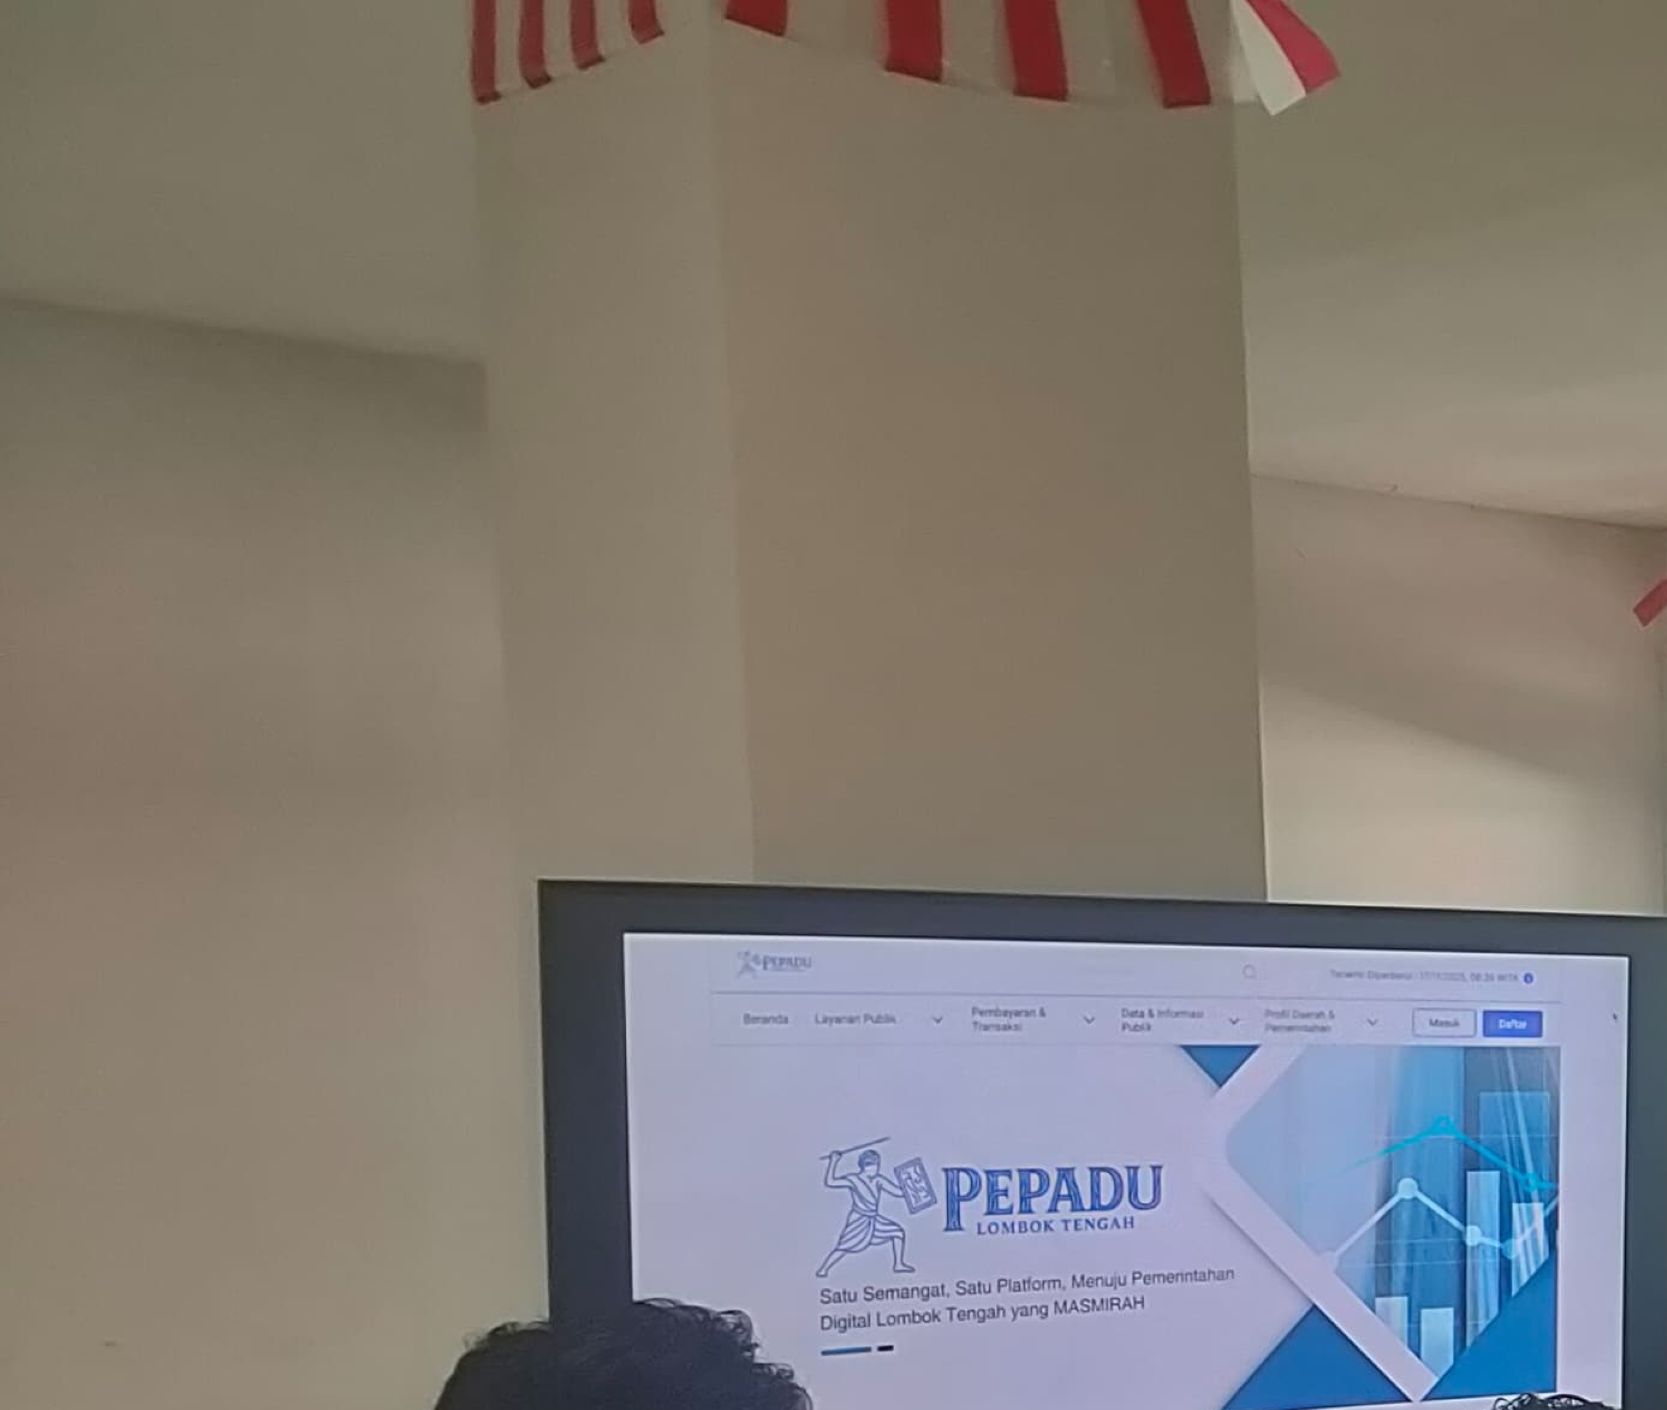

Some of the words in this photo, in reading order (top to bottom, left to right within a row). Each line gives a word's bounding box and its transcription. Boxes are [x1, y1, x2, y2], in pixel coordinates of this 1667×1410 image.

[1121, 1008, 1145, 1020] Data
[941, 1164, 1165, 1232] PEPADU
[976, 1218, 1055, 1236] LOMBOK
[1061, 1216, 1136, 1232] TENGAH
[819, 1288, 859, 1305] Satu
[862, 1282, 951, 1303] Semangat,
[954, 1280, 992, 1297] Satu
[997, 1277, 1067, 1295] Platform,
[1071, 1272, 1128, 1293] Menuju
[1131, 1266, 1236, 1287] Pemerintahan
[820, 1312, 872, 1334] Digital
[876, 1307, 941, 1328] Lombok
[946, 1303, 1006, 1326] Tengah
[1010, 1304, 1049, 1322] yang
[1053, 1295, 1145, 1316] MASMIRAH
